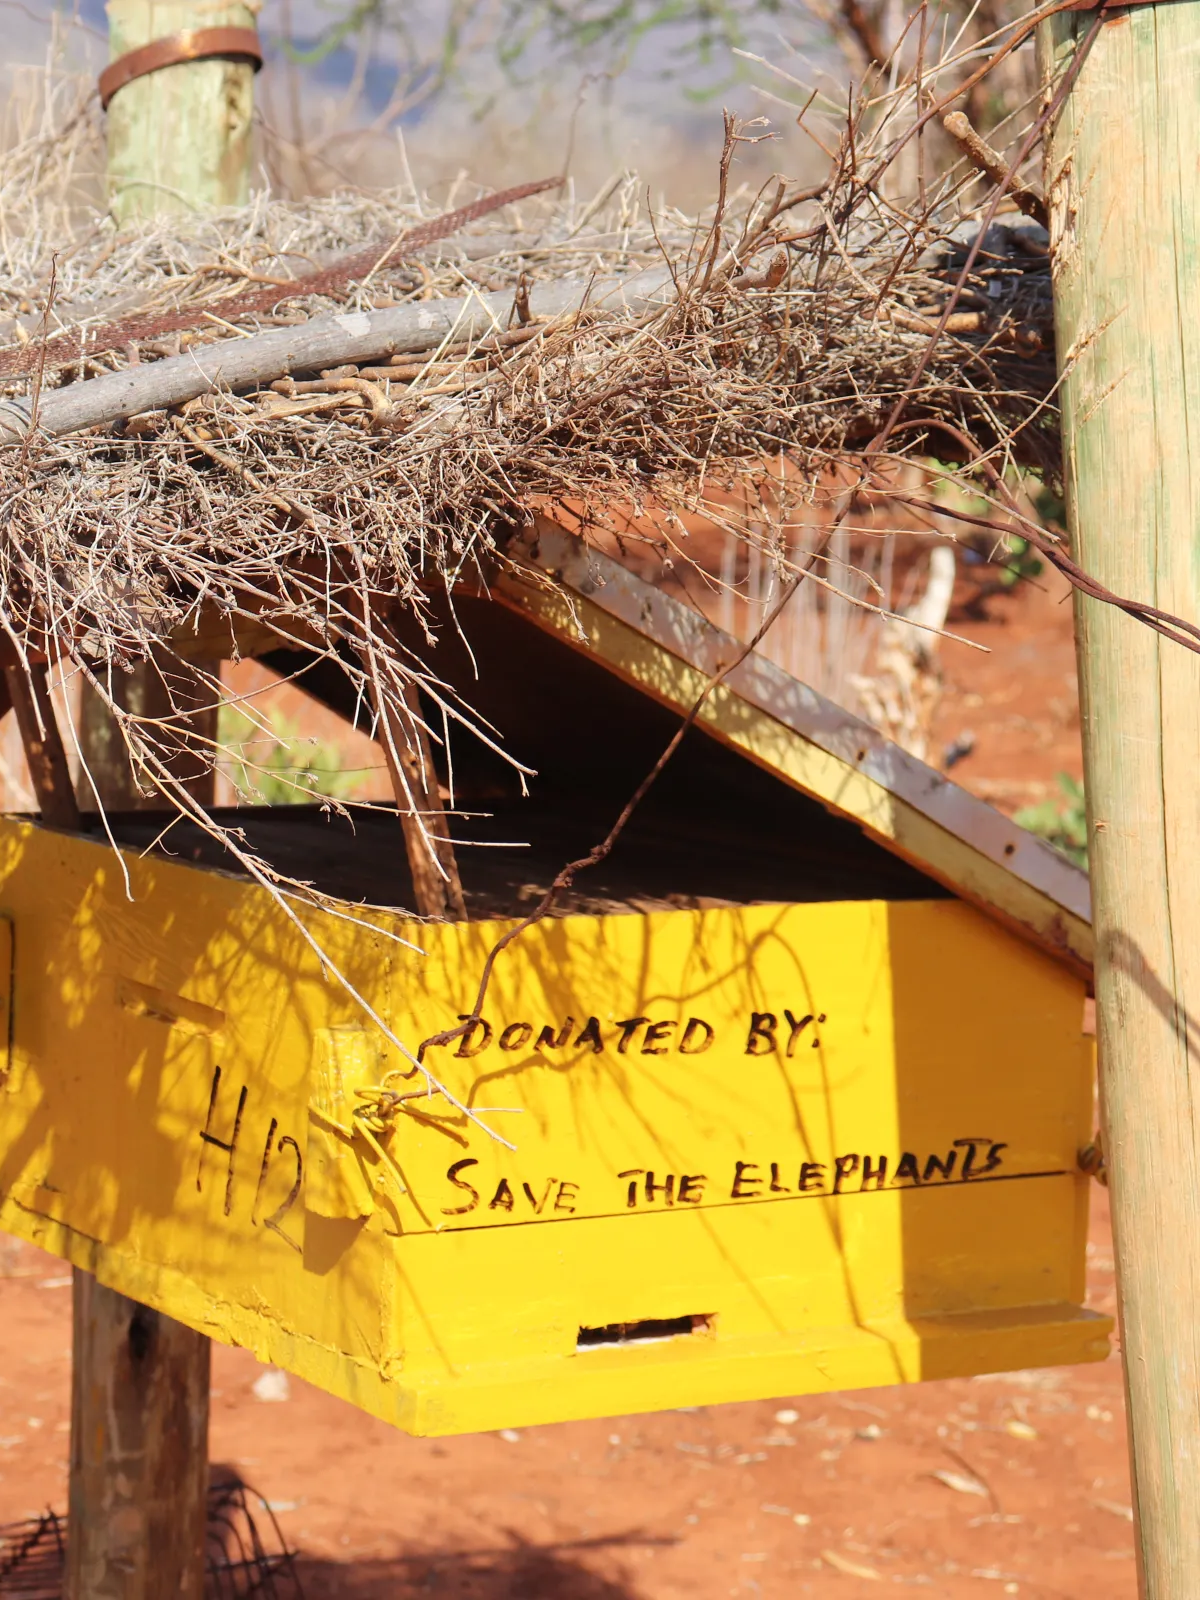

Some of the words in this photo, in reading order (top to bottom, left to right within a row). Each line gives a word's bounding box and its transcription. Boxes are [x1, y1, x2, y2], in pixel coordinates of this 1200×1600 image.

[452, 1014, 715, 1058] DONATED
[744, 1010, 827, 1058] BY:
[440, 1158, 580, 1215] SAVE
[618, 1169, 708, 1208] THE
[730, 1138, 1008, 1195] ELEPHANTS
